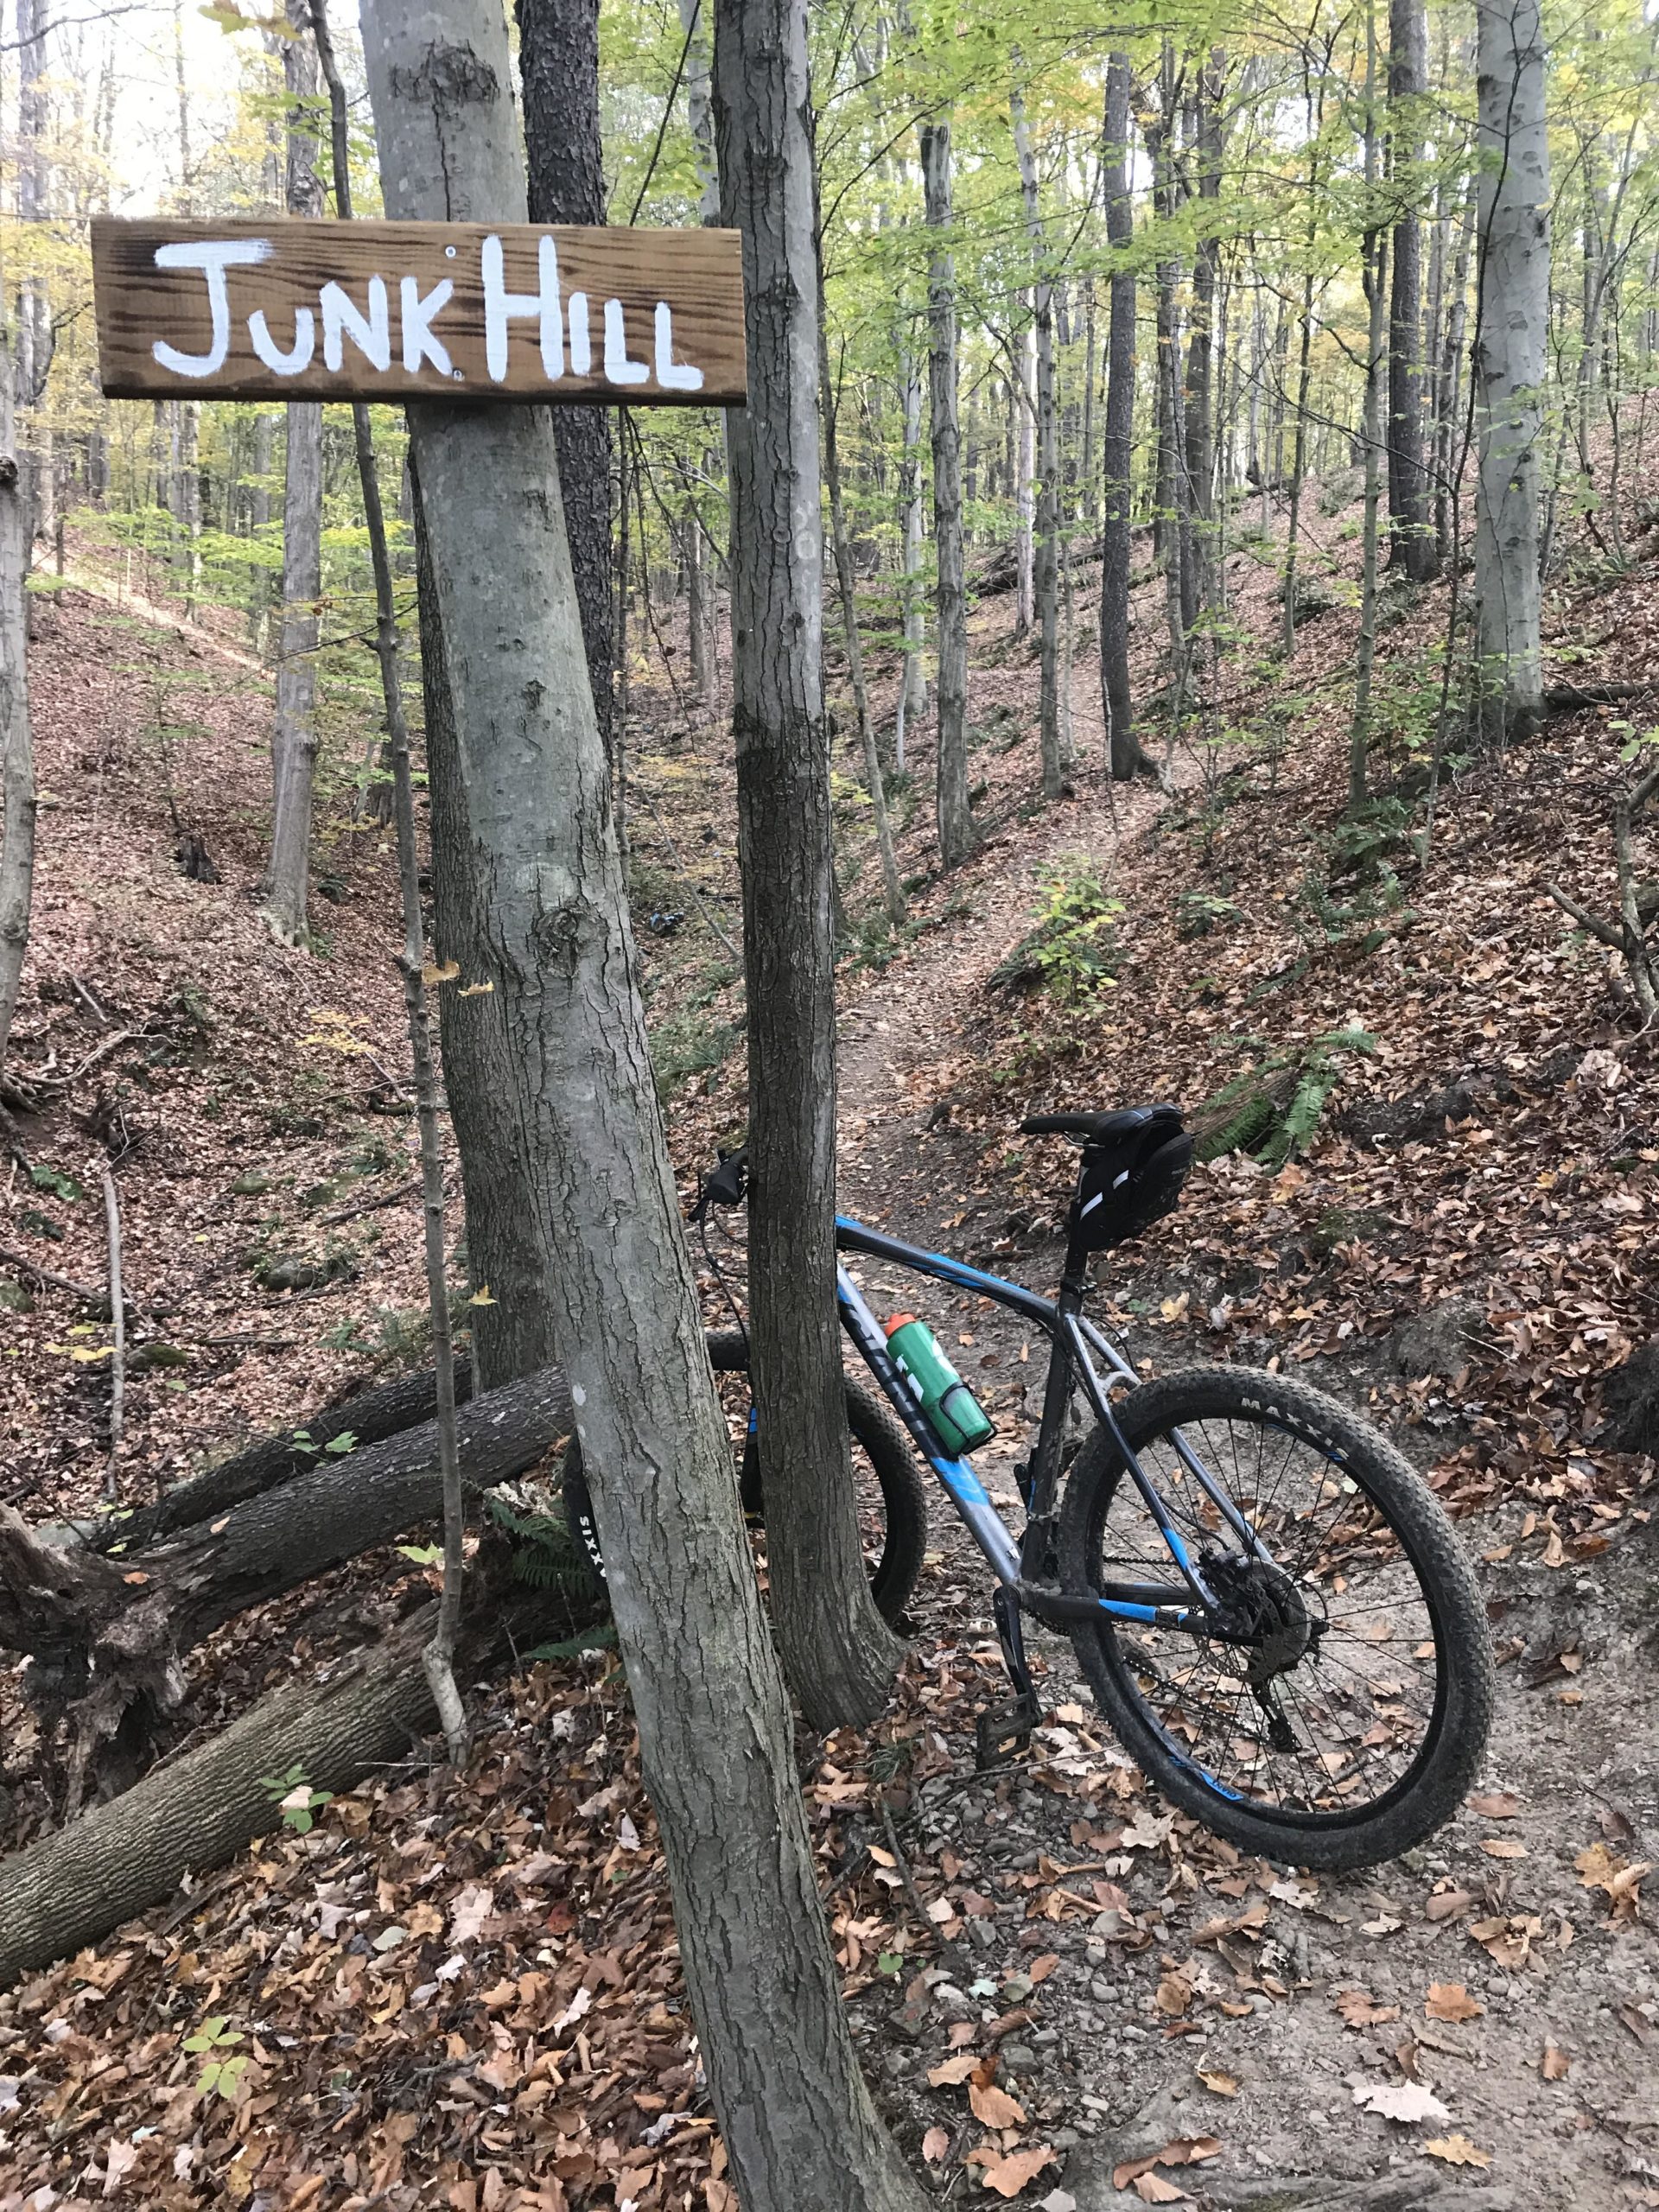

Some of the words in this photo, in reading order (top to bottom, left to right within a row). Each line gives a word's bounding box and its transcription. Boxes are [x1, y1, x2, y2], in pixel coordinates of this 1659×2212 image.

[152, 238, 454, 377] JUNK
[481, 234, 703, 391] HILL
[1241, 1397, 1350, 1460] MAXXIS
[579, 1516, 607, 1578] AXXIS
